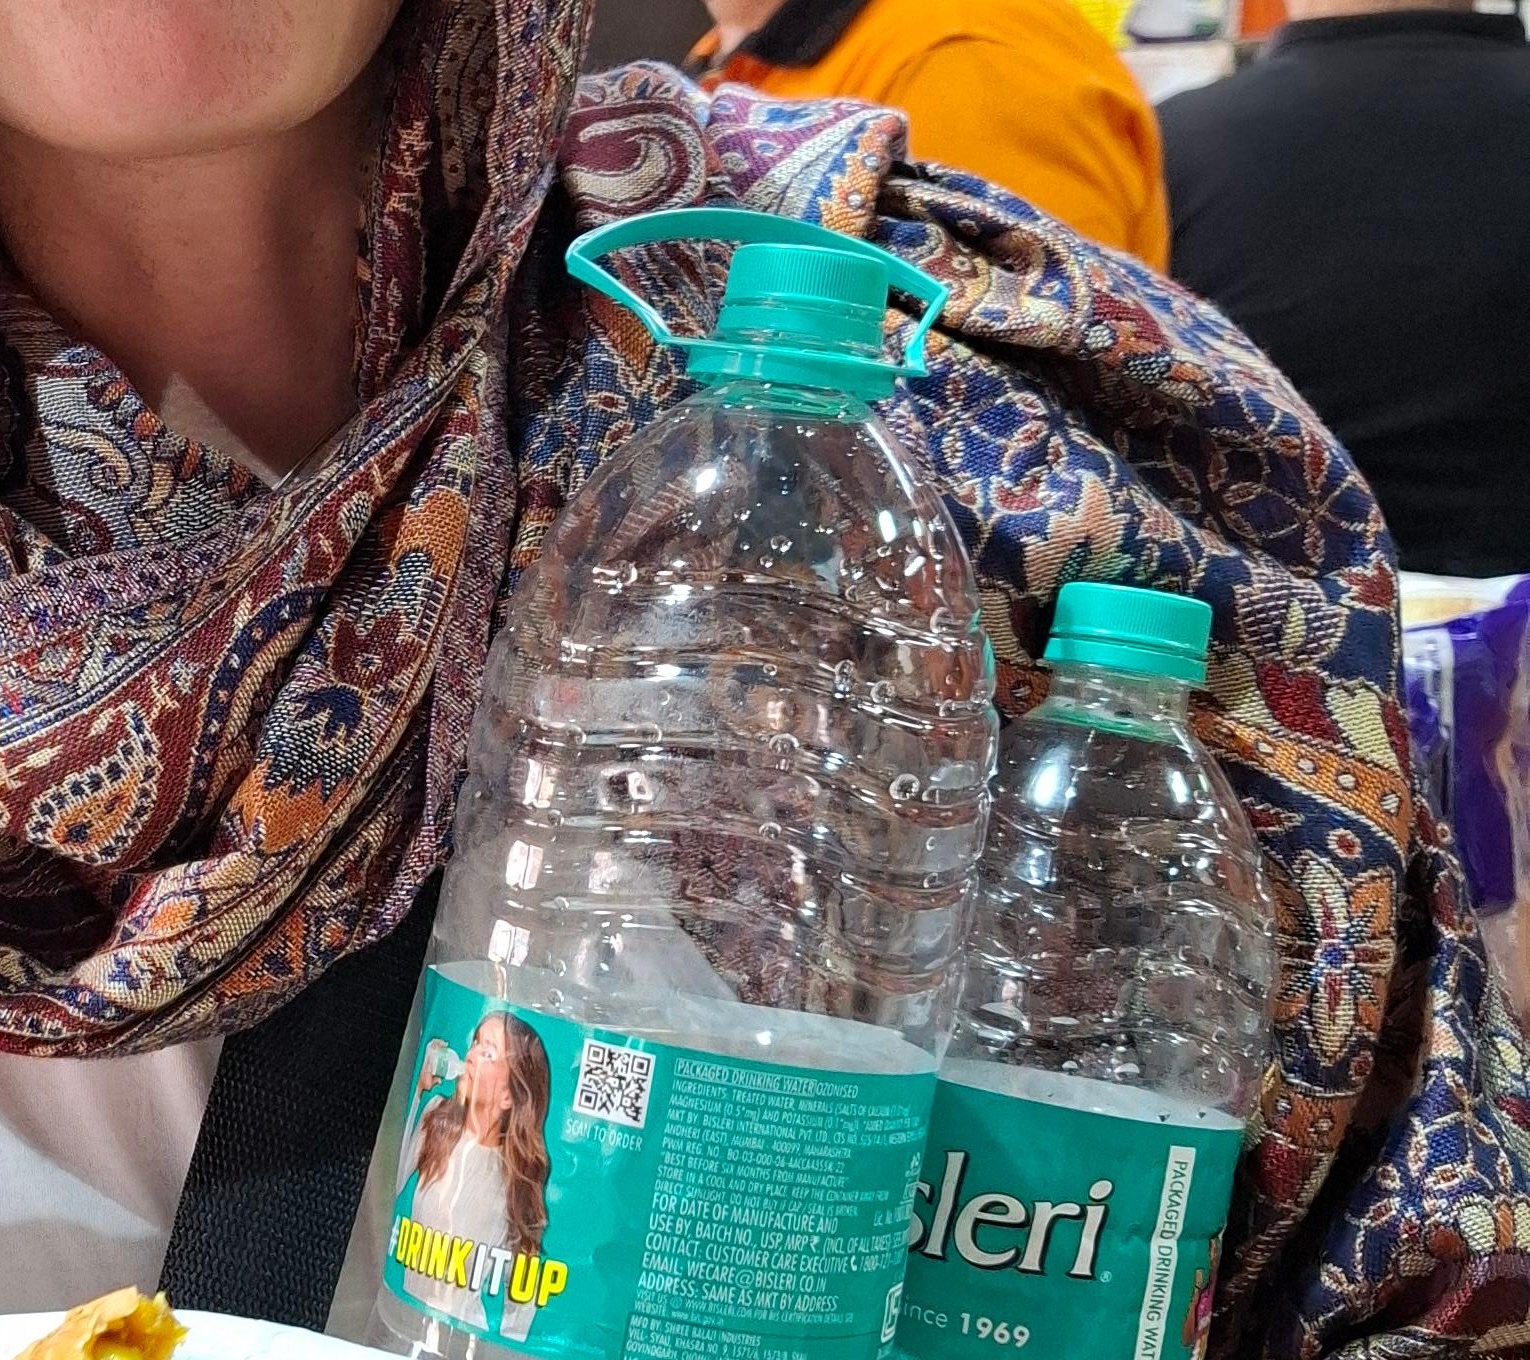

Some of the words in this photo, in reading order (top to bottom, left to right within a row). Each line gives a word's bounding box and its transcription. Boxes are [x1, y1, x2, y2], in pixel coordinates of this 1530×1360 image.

[677, 1060, 729, 1082] PACKAGED
[732, 1070, 780, 1089] DRINKING
[783, 1078, 815, 1096] WATER
[816, 1082, 859, 1099] OZONISED
[733, 1089, 766, 1106] TREATED
[667, 1109, 685, 1122] MKT
[703, 1114, 734, 1130] BISLERI
[736, 1120, 796, 1140] INTERNATIONAL
[669, 1094, 721, 1113] MAGNESIUM
[762, 1109, 780, 1122] AND
[565, 1118, 591, 1139] SCAN
[594, 1125, 606, 1142] TO
[609, 1129, 643, 1151] ORDER
[664, 1123, 701, 1139] ANDHERI
[657, 1165, 684, 1181] STORE
[686, 1172, 696, 1184] IN
[698, 1173, 704, 1185] A
[706, 1174, 726, 1189] COOL
[729, 1179, 746, 1192] AND
[748, 1181, 764, 1194] DRY
[792, 1186, 810, 1199] KEEP
[811, 1188, 824, 1201] THE
[688, 1156, 719, 1173] BEFORE
[721, 1162, 734, 1175] SIX
[737, 1165, 770, 1181] MONTHS
[772, 1170, 794, 1183] FROM
[652, 1192, 677, 1213] FOR
[679, 1197, 710, 1219] DATE
[712, 1203, 729, 1221] OF
[730, 1206, 815, 1233] MANUFACTURE
[817, 1217, 839, 1235] AND
[654, 1179, 684, 1196] DIRECT
[730, 1193, 742, 1206] DO
[744, 1196, 761, 1208] NOT
[763, 1198, 778, 1211] BUY
[788, 1201, 802, 1212] CAP
[808, 1203, 825, 1217] SEAL
[827, 1205, 834, 1217] IS
[908, 1150, 1115, 1280] sleri
[1157, 1159, 1188, 1240] PACKAGED
[649, 1211, 674, 1233] USE
[675, 1217, 692, 1240] BY,
[695, 1221, 733, 1243] BATCH
[847, 1237, 858, 1253] OF
[858, 1236, 870, 1253] ALL
[642, 1251, 684, 1276] EMAIL:
[645, 1232, 702, 1258] CONTACT:
[705, 1243, 770, 1269] CUSTOMER
[771, 1252, 798, 1271] CARE
[799, 1254, 849, 1273] EXECUTIVE
[638, 1271, 698, 1299] ADDRESS:
[702, 1283, 736, 1305] SAME
[737, 1288, 753, 1307] AS
[754, 1290, 779, 1309] MKT
[780, 1292, 794, 1310] BY
[794, 1294, 840, 1312] ADDRESS
[1146, 1245, 1174, 1322] DRINKING
[664, 1322, 689, 1337] SHREE
[692, 1327, 717, 1341] BALAJI
[718, 1331, 761, 1347] INDUSTRIES
[903, 1294, 948, 1328] ince
[960, 1312, 1031, 1349] 1969
[675, 1337, 705, 1352] KHASRA
